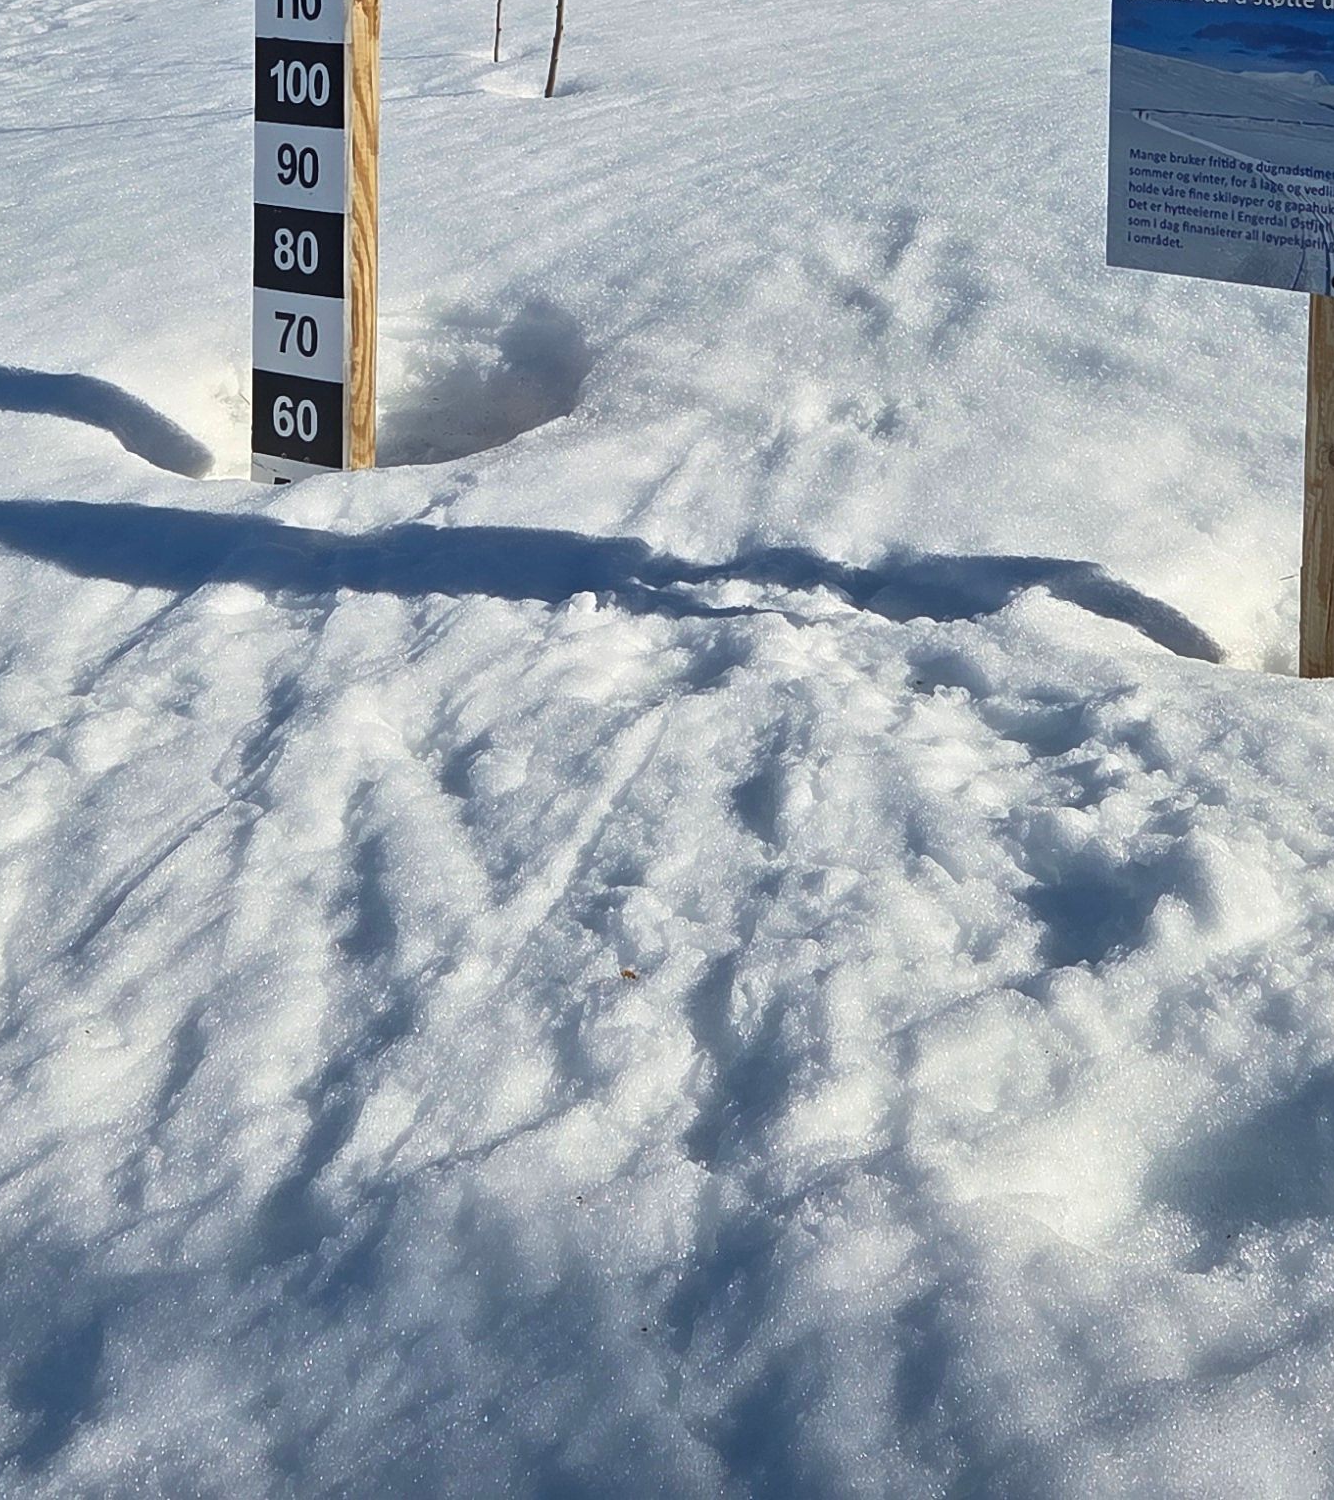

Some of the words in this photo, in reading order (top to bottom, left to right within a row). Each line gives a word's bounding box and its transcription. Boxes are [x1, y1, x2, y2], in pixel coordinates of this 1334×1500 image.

[270, 59, 330, 107] 100
[277, 142, 319, 189] 90
[1129, 148, 1167, 164] Mange
[1169, 152, 1206, 166] bruker
[1208, 156, 1237, 170] fritid
[1239, 161, 1254, 173] og
[1128, 181, 1160, 195] holde
[1162, 185, 1186, 198] våre
[1188, 187, 1210, 201] fine
[1212, 190, 1265, 208] skiløyper
[1267, 199, 1282, 212] og
[1129, 166, 1174, 180] sommer
[1176, 172, 1190, 184] og
[1192, 172, 1228, 187] vinter,
[1231, 175, 1248, 188] for
[1250, 176, 1257, 189] å
[1260, 179, 1284, 193] lage
[1287, 184, 1301, 196] og
[1128, 198, 1147, 211] Det
[1150, 203, 1162, 213] er
[1164, 202, 1229, 220] hytteeierne
[1237, 211, 1287, 227] Engerdal
[1128, 216, 1151, 228] som
[1159, 219, 1180, 234] dag
[1182, 221, 1243, 239] finansierer
[1245, 229, 1259, 241] all
[1134, 234, 1184, 249] området.
[273, 227, 319, 275] 80
[274, 311, 319, 358] 70
[272, 395, 318, 442] 60
